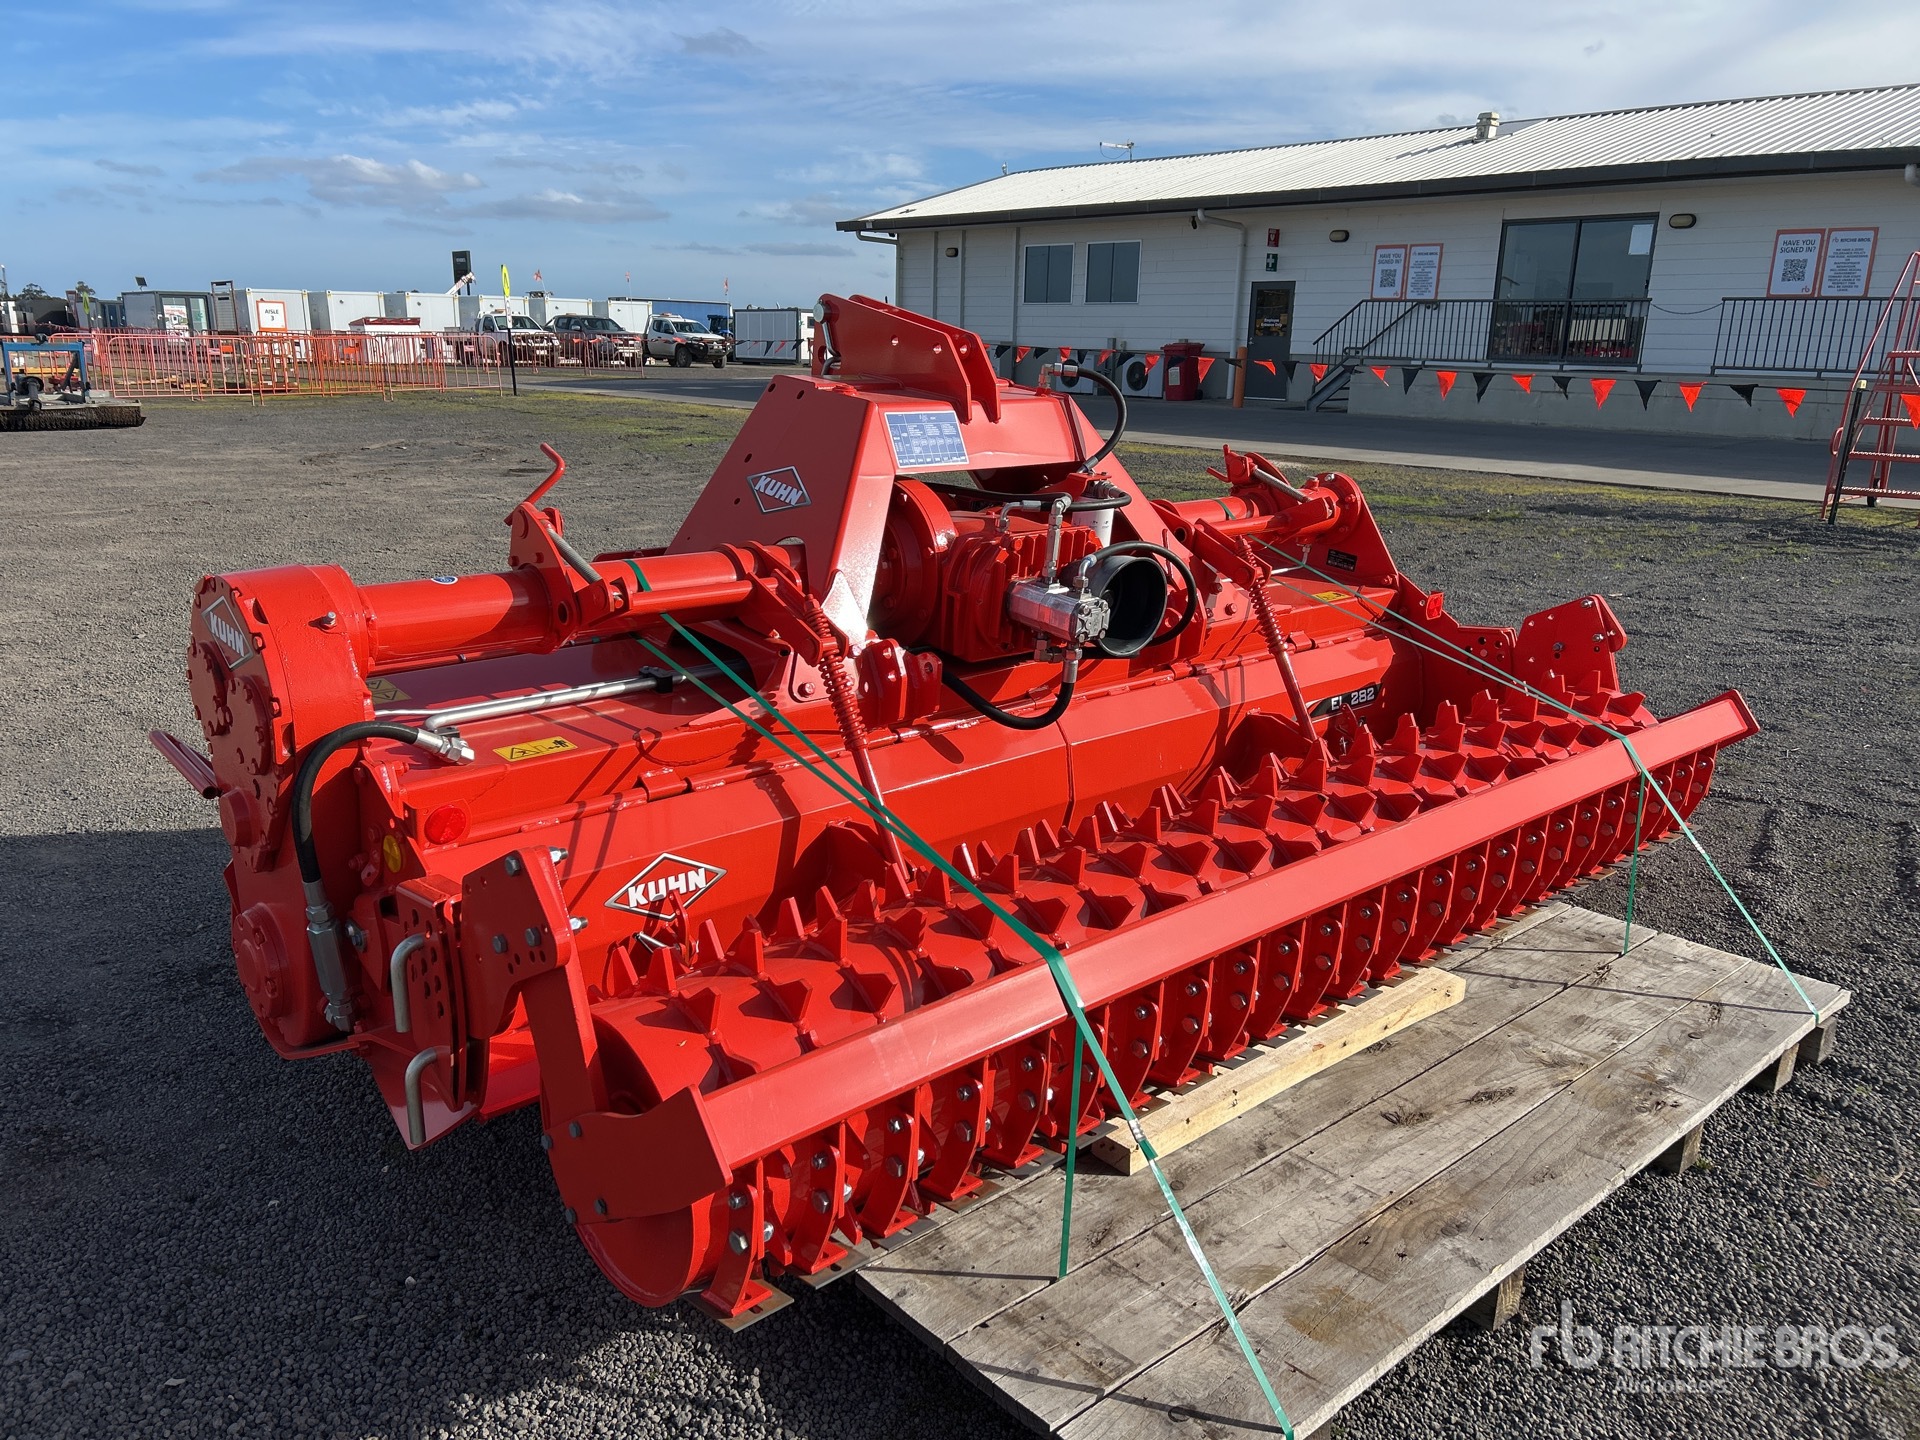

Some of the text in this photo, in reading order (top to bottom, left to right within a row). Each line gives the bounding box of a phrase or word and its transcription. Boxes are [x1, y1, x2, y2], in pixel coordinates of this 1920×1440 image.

[1801, 285, 1810, 293] rb
[754, 475, 803, 506] KUHN
[209, 611, 244, 657] KUHN
[1351, 687, 1375, 705] 282
[628, 867, 706, 908] KUHN
